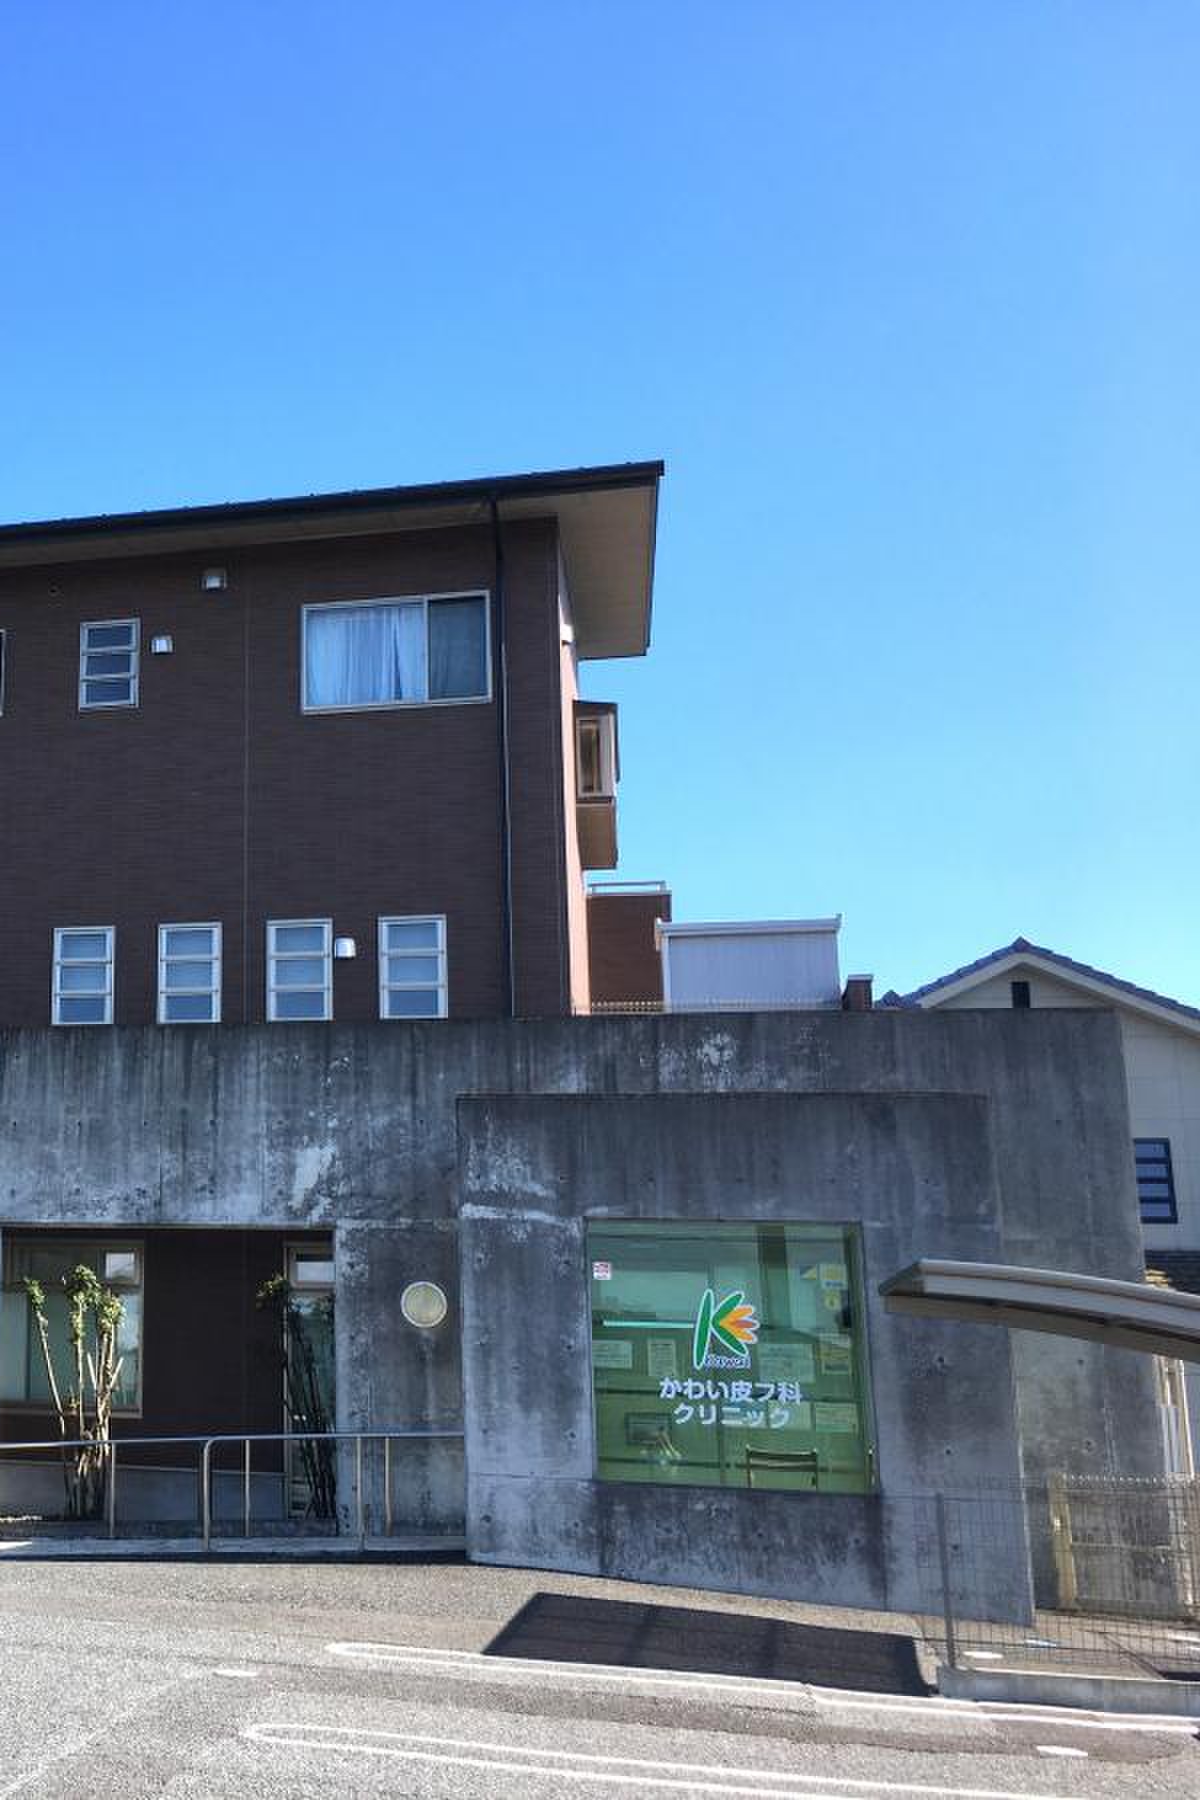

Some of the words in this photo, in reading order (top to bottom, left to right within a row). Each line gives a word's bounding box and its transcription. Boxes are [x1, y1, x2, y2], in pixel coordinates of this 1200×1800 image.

[659, 1376, 803, 1405] かわい皮フ科
[673, 1402, 792, 1429] クリニック
